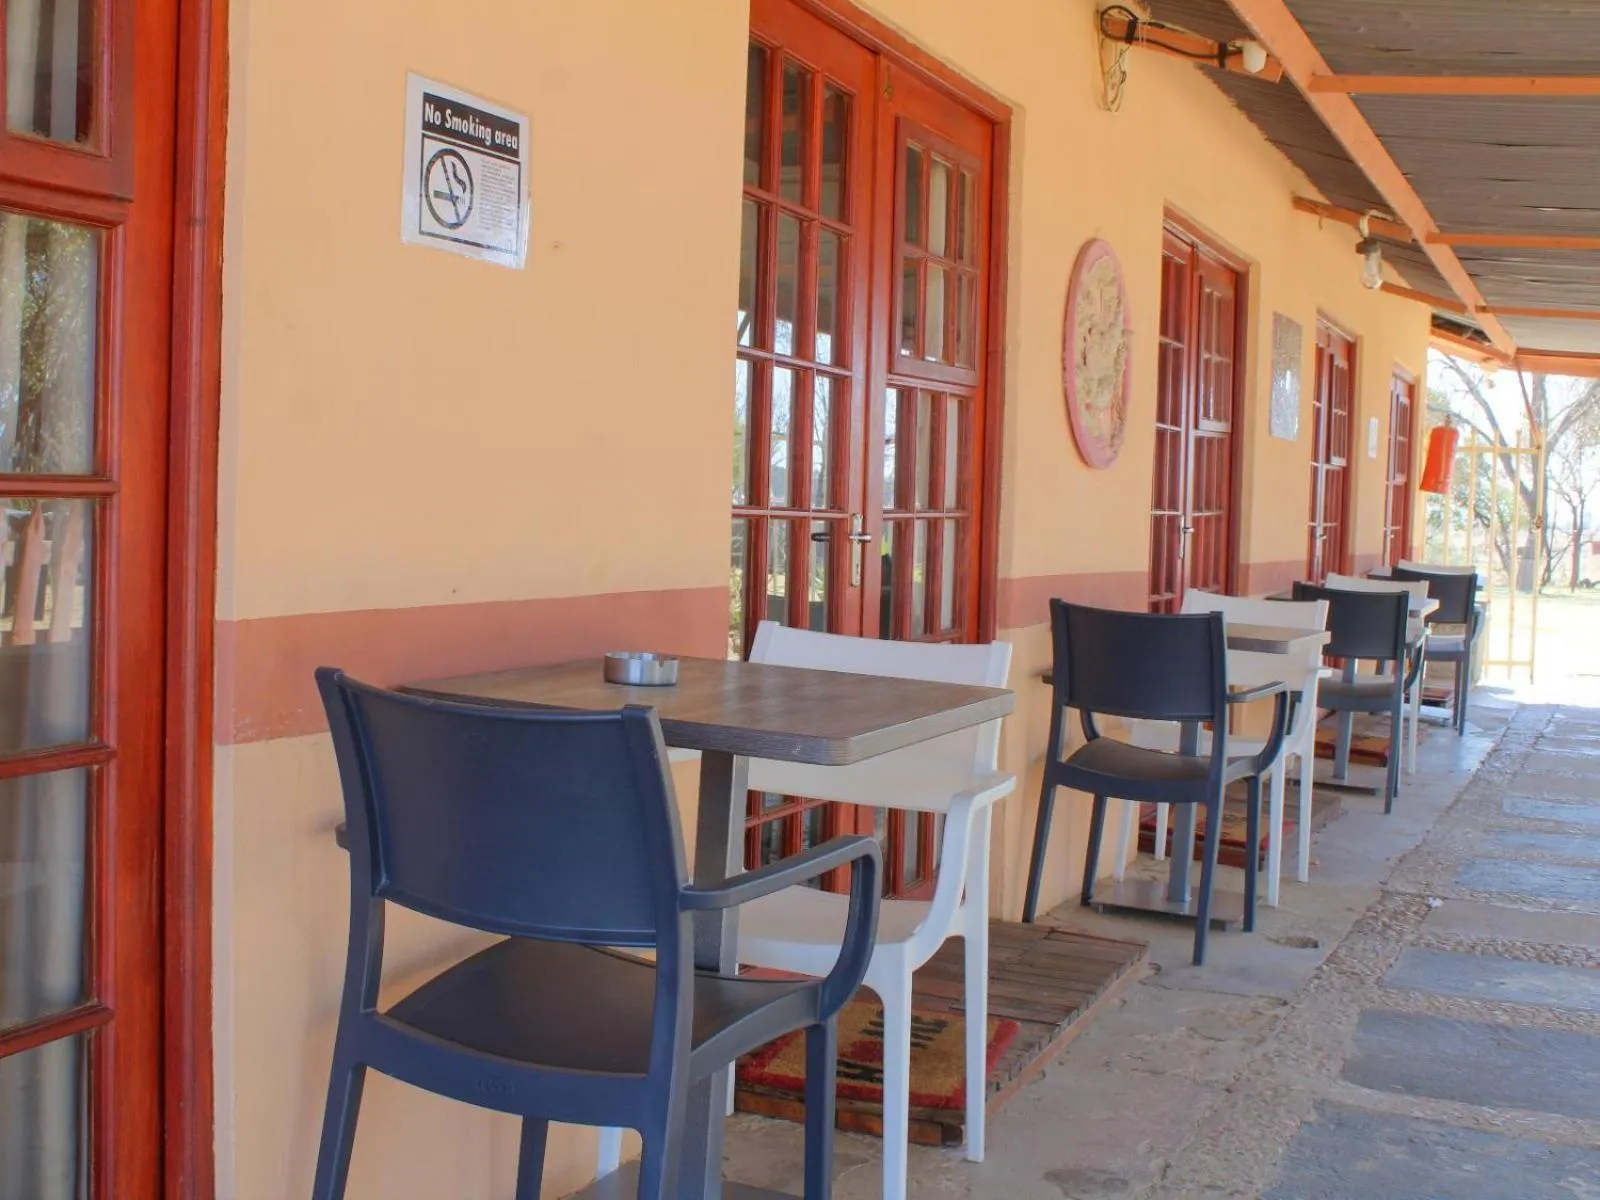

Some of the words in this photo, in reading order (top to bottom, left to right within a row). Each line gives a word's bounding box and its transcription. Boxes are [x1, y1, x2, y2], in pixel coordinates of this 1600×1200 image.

[424, 102, 442, 125] No
[445, 108, 492, 146] Smoking
[495, 129, 519, 150] area
